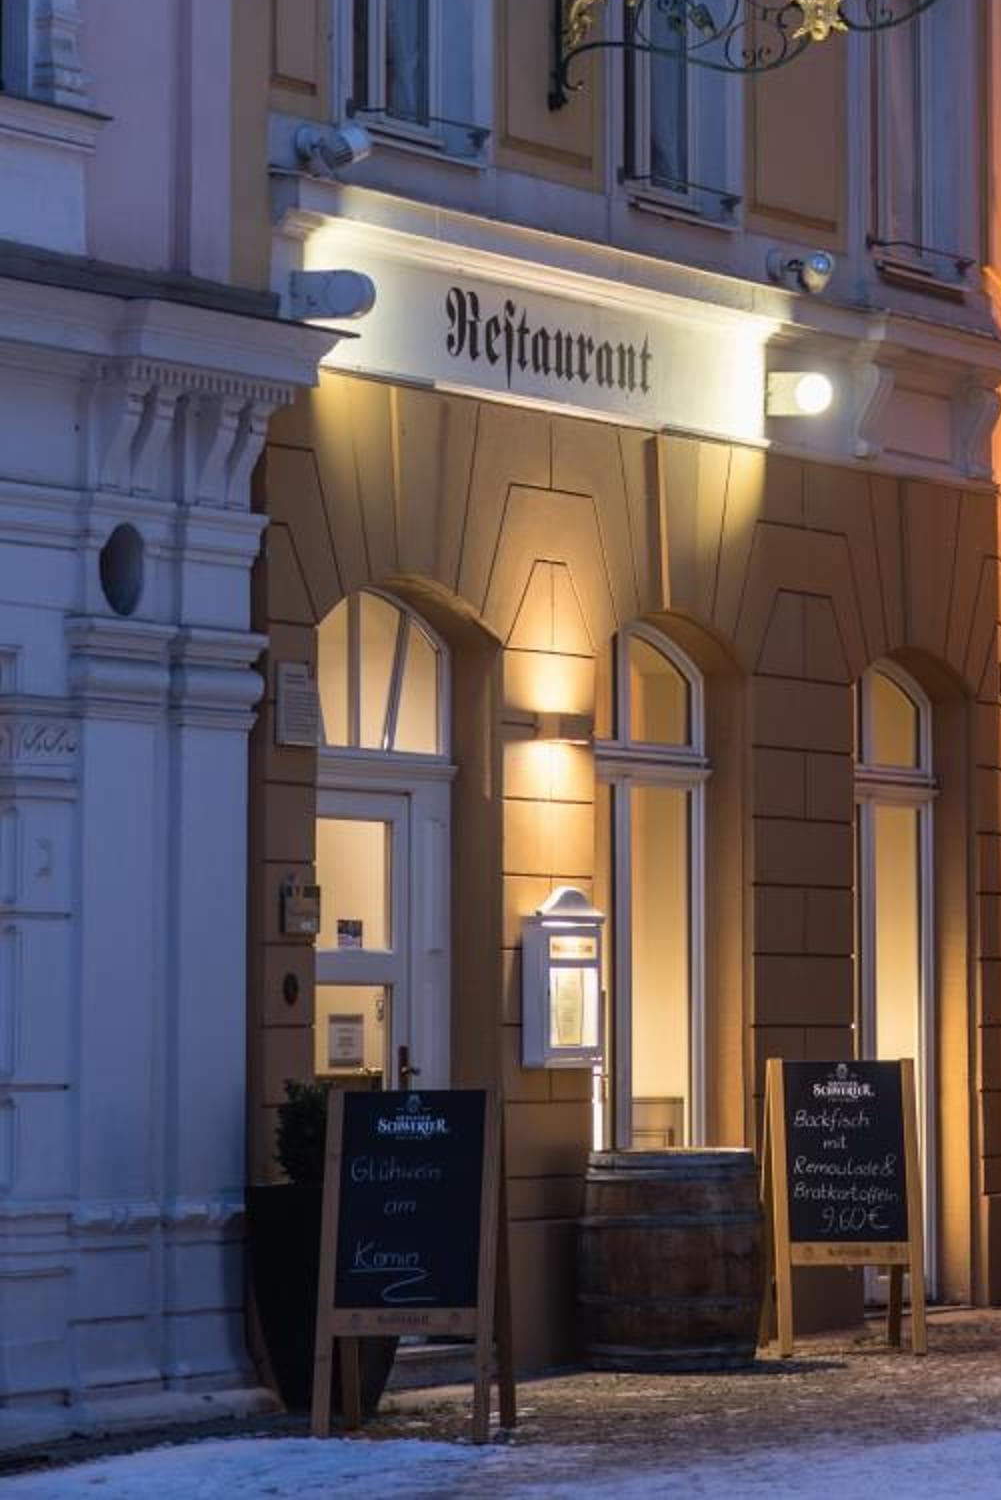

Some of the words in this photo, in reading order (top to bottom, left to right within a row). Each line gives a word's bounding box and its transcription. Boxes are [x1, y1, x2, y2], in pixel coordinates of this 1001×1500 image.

[793, 1107, 870, 1132] Backfisch
[823, 1133, 847, 1150] mit
[793, 1155, 879, 1175] Remoulade
[880, 1153, 897, 1177] &
[383, 1200, 417, 1215] am
[354, 1240, 420, 1267] Kamin
